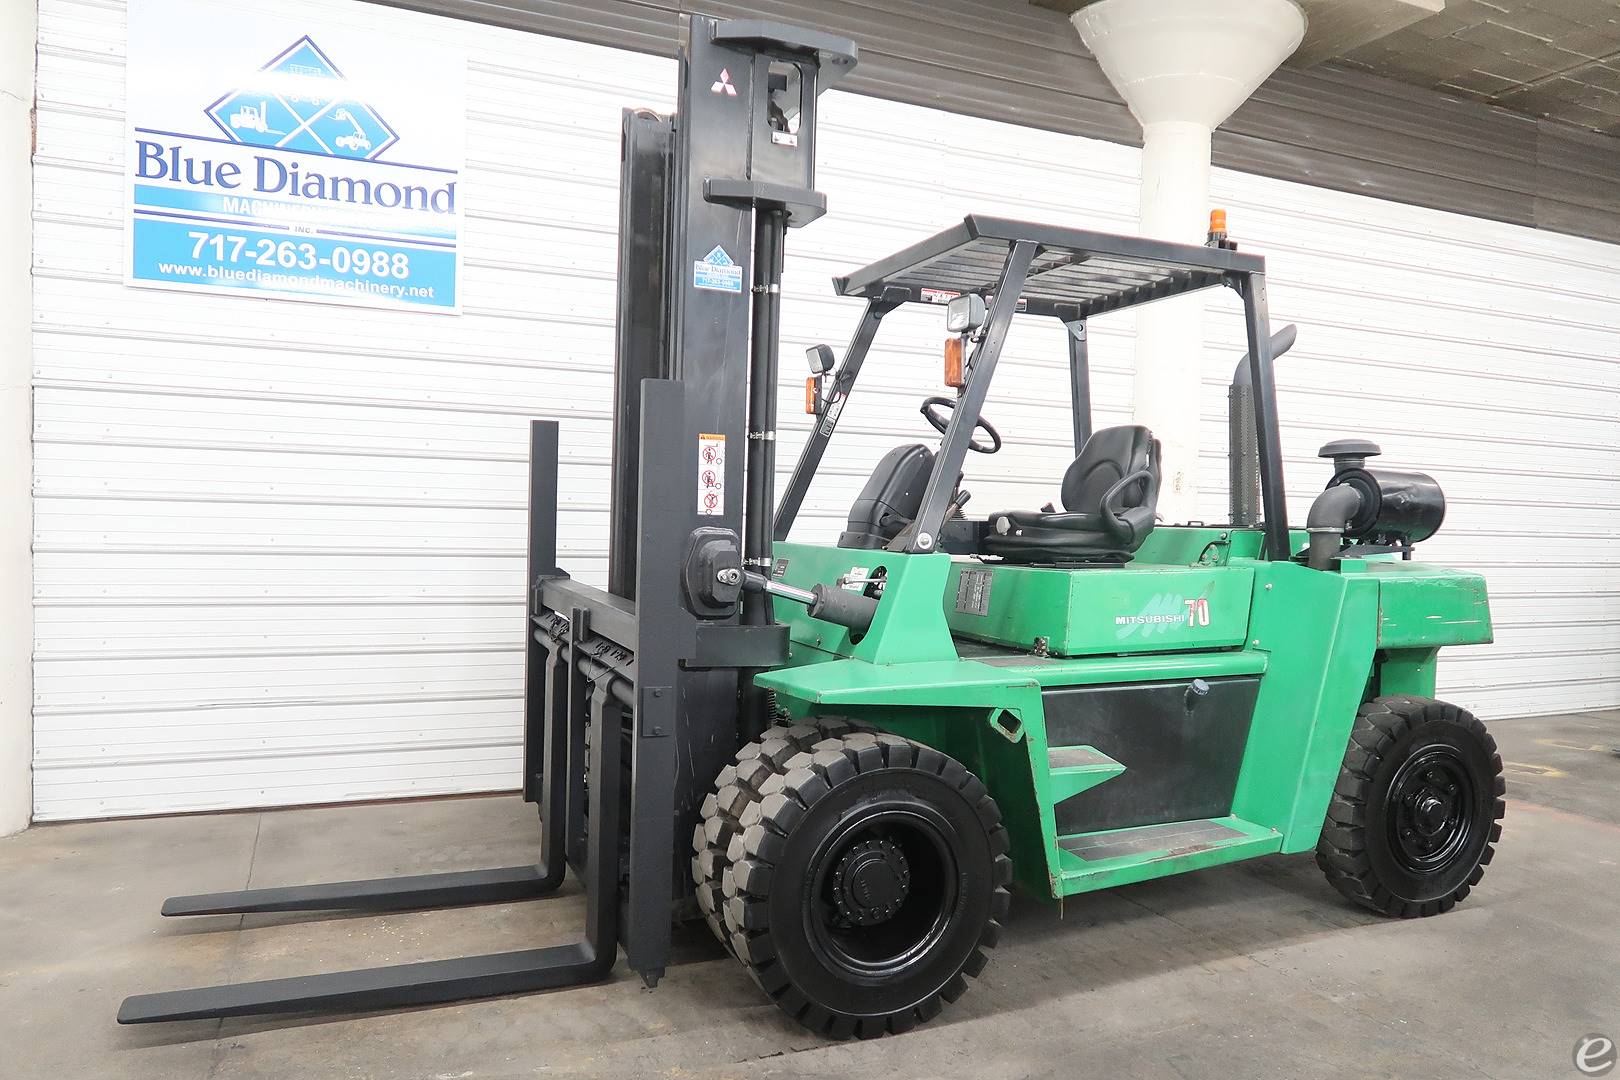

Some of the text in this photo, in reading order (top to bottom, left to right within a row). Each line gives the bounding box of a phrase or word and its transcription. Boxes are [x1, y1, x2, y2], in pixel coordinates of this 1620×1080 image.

[135, 140, 457, 215] Blue Diamond
[295, 226, 314, 234] INC.
[187, 231, 410, 280] 717-263-0988
[158, 262, 434, 298] www.bluediamondmachinery.net
[1115, 598, 1210, 627] MITSUBISHI 70
